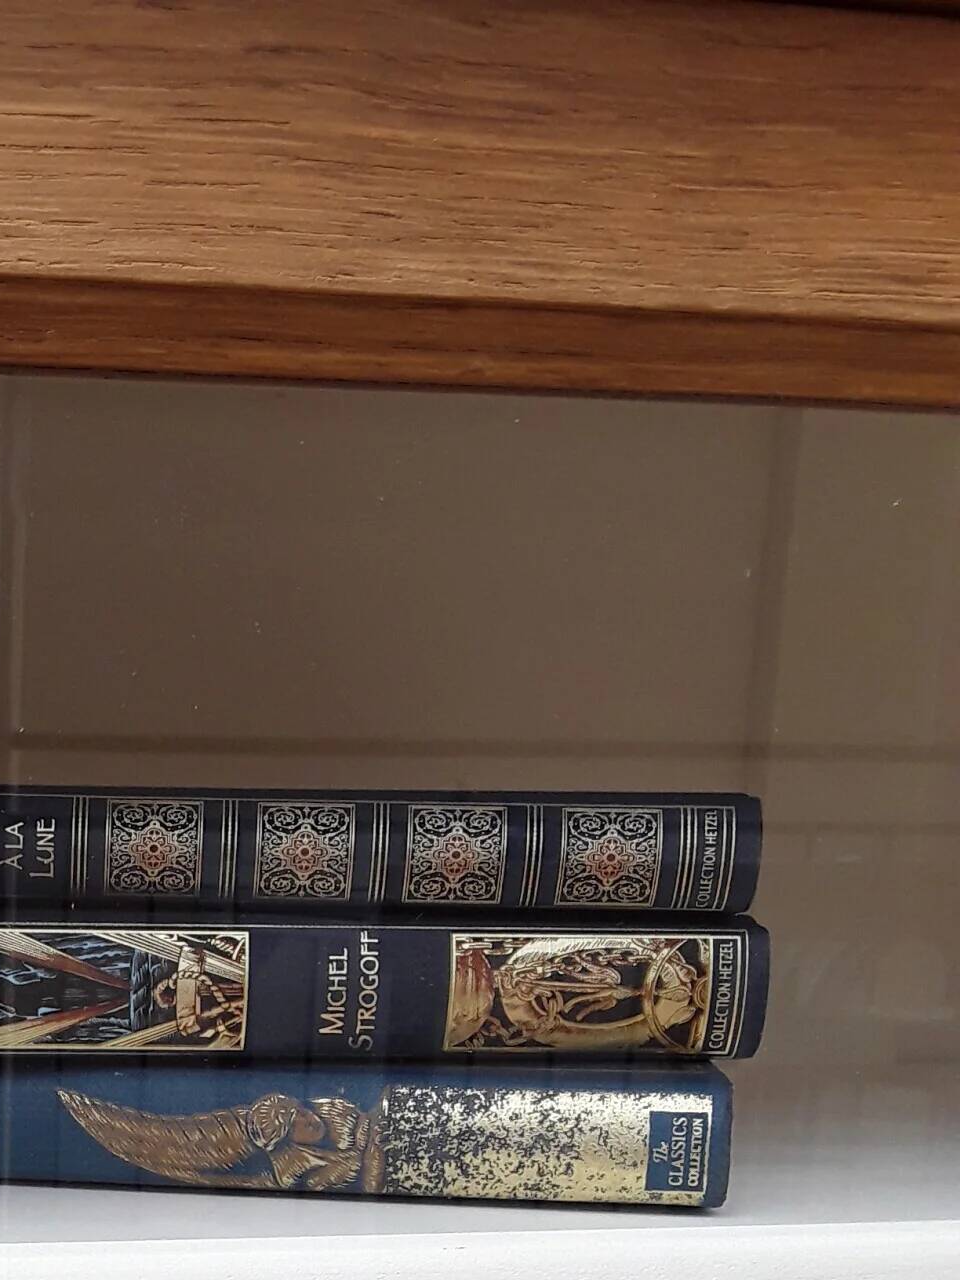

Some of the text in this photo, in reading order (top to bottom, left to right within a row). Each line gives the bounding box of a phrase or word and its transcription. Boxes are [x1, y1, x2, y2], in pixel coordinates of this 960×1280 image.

[5, 821, 24, 850] LA
[29, 818, 56, 878] LUNE
[695, 809, 718, 908] COLLECTION HETZEL
[319, 947, 348, 1034] MICHEL
[348, 930, 379, 1051] STROGOFF
[708, 941, 734, 1049] COLLECTION HETZEL
[652, 1141, 669, 1163] The
[668, 1117, 688, 1187] CLASSICS
[687, 1118, 704, 1187] COLLECTION
